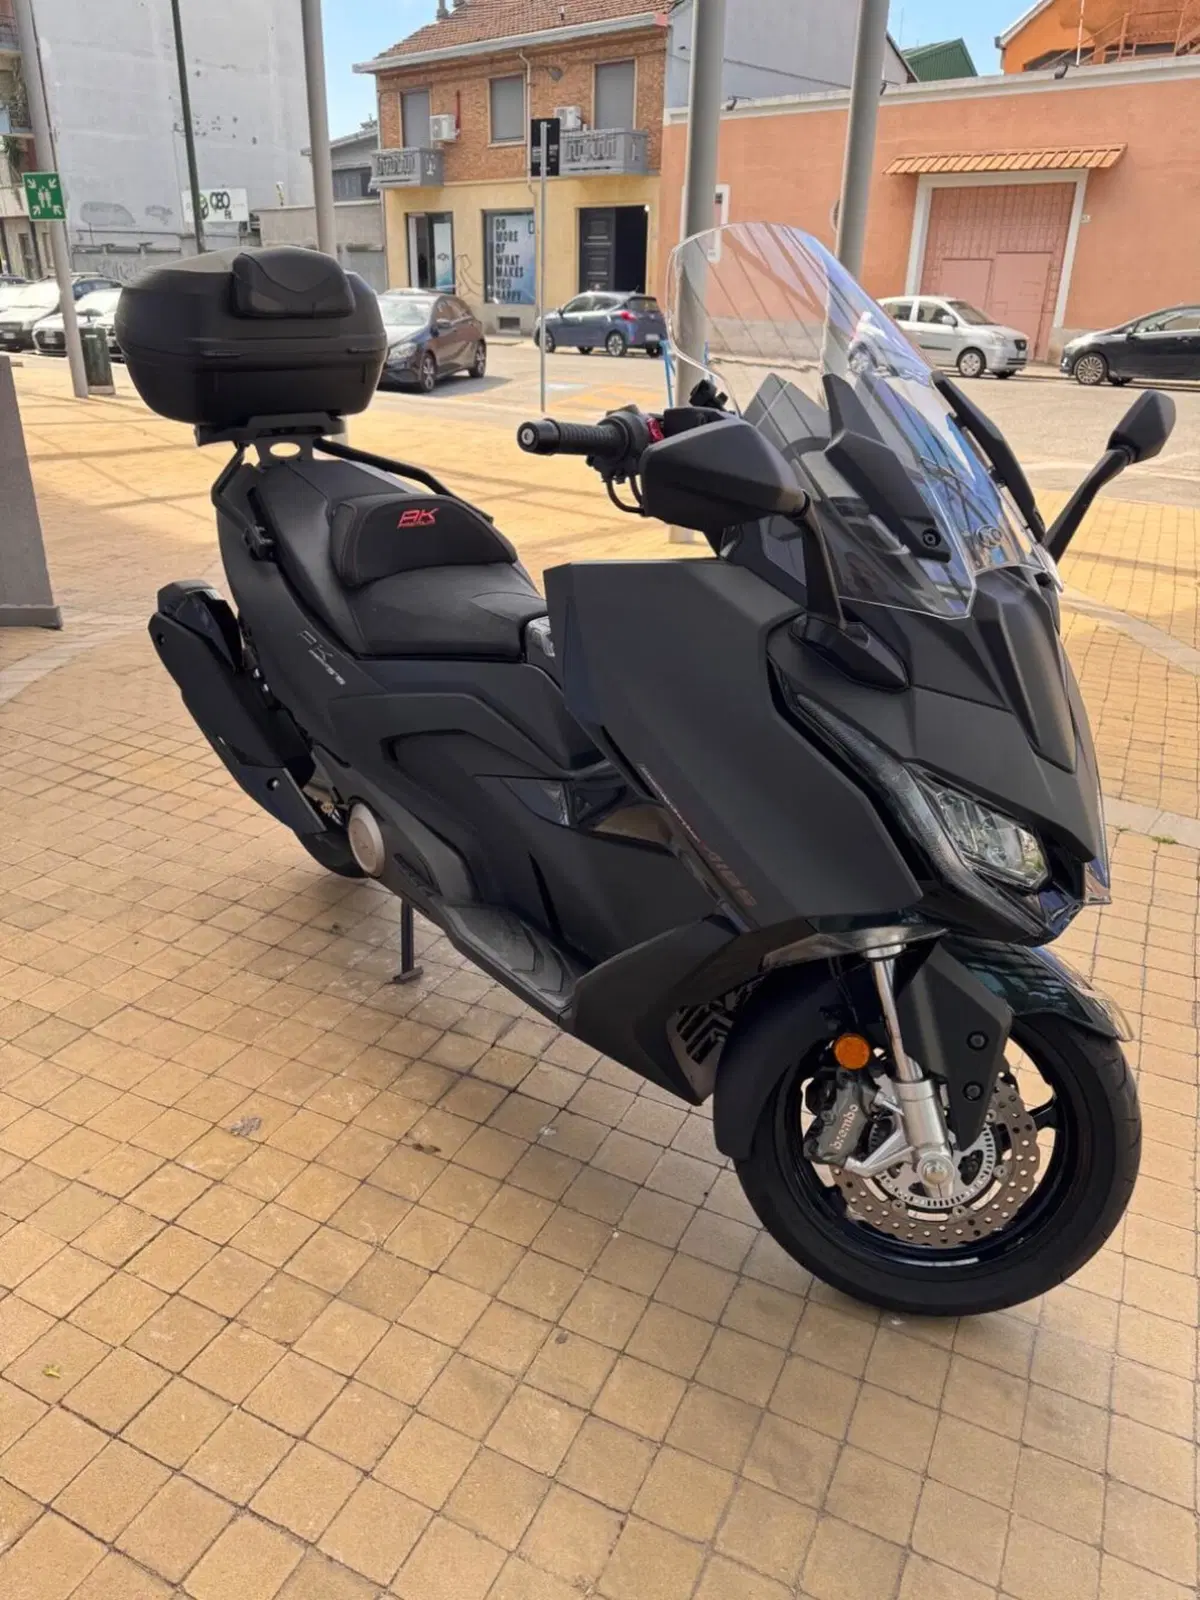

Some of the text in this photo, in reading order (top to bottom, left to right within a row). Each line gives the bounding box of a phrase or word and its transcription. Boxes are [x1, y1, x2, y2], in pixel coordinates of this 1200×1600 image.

[496, 219, 506, 230] DO
[496, 231, 518, 242] MORE
[496, 243, 506, 254] OF
[496, 255, 520, 266] WHAT
[496, 266, 524, 278] MAKES
[496, 278, 512, 290] YOU
[496, 289, 521, 301] HAPPY
[397, 508, 440, 529] AK
[829, 1104, 859, 1150] brembo
